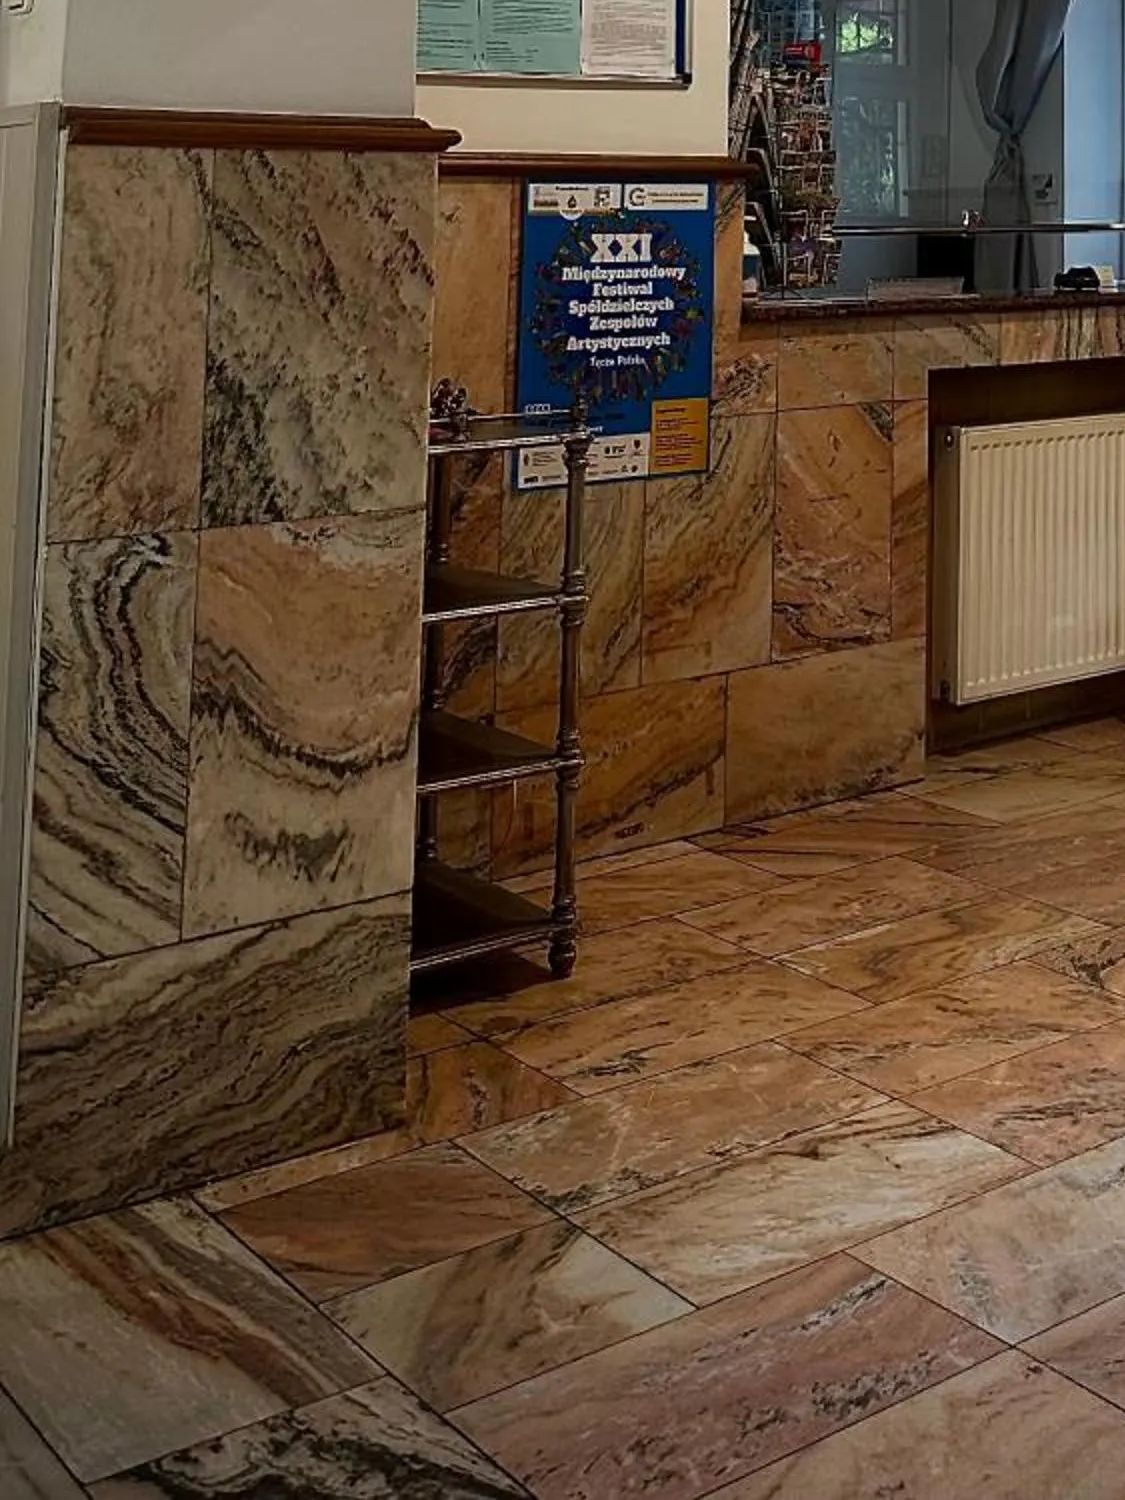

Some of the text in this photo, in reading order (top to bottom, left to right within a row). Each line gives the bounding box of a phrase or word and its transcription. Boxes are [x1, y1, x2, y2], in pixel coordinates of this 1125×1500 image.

[590, 233, 653, 263] XXI
[562, 265, 686, 283] Międzynarodowy
[592, 282, 653, 297] Festiwal
[568, 297, 675, 316] Spółdzielczych
[566, 332, 671, 353] Artystycznych
